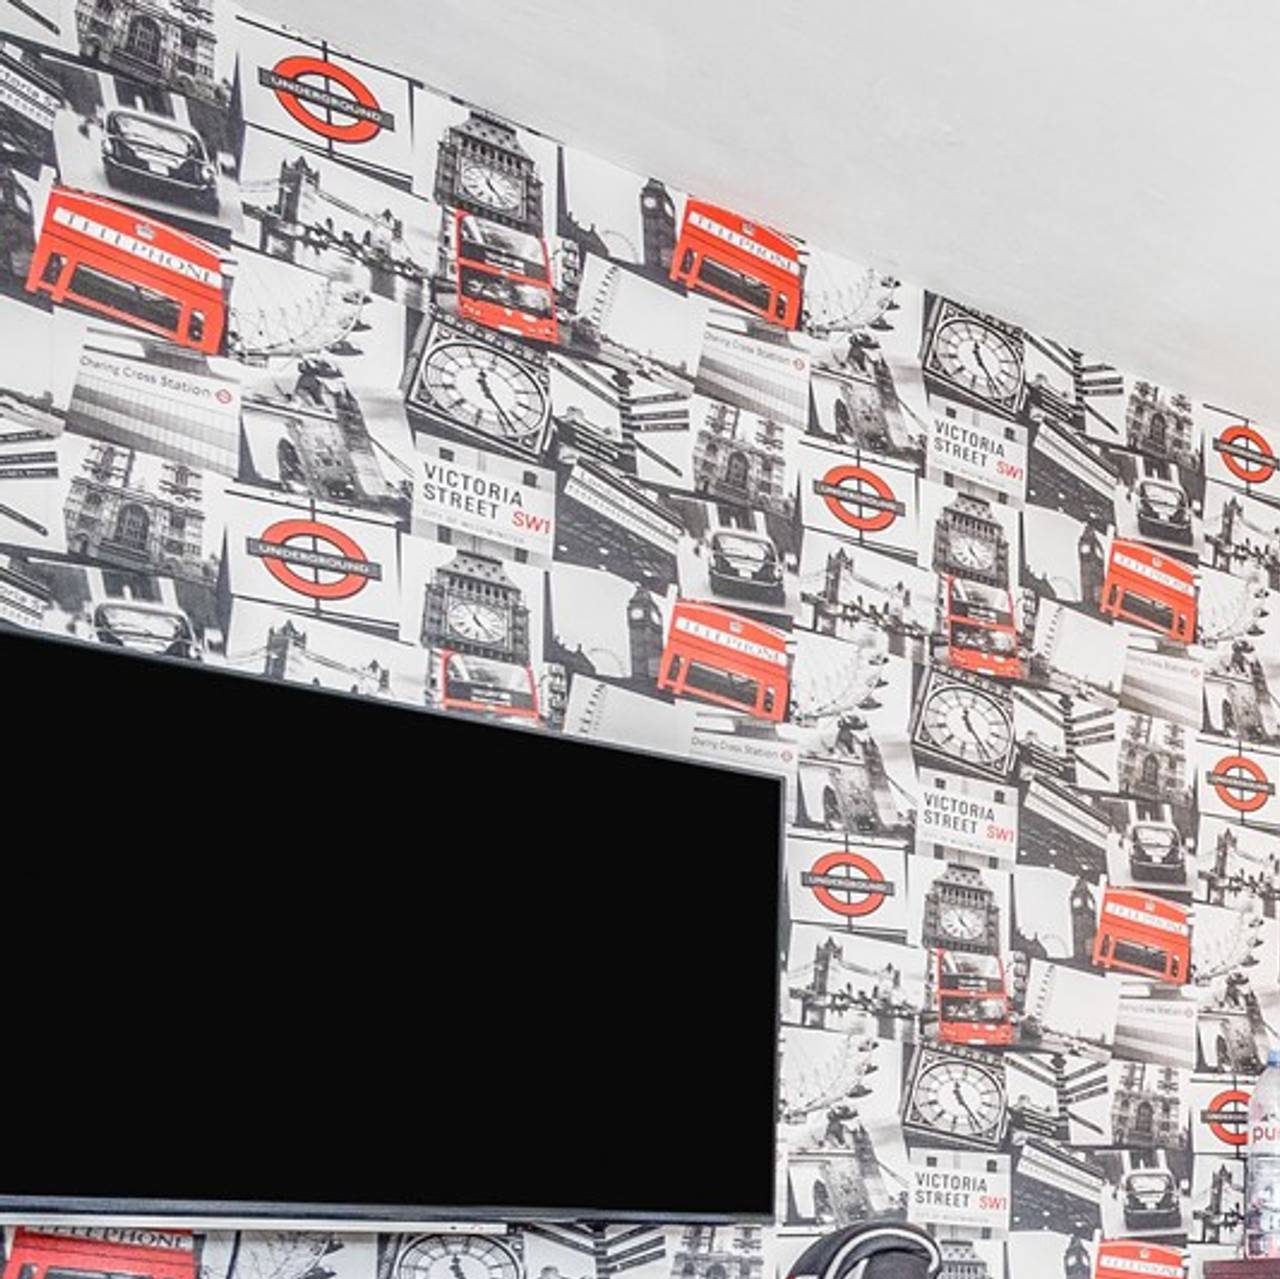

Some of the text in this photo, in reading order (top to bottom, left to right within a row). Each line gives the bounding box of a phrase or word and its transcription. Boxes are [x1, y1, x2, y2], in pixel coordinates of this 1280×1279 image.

[66, 213, 211, 283] TELEPHONE
[80, 355, 211, 397] Charing Cross Station
[934, 420, 1004, 457] VICTORIA
[934, 437, 987, 467] STREET
[996, 461, 1023, 480] SW1
[424, 462, 523, 507] VICTORIA
[424, 484, 499, 519] STREET
[512, 511, 550, 534] SW1
[259, 544, 371, 573] UNDERGROUND
[923, 792, 995, 822] VICTORIA
[923, 810, 1015, 842] STREET SW1
[915, 1172, 988, 1193] VICTORIA
[915, 1190, 1007, 1211] STREET SW1
